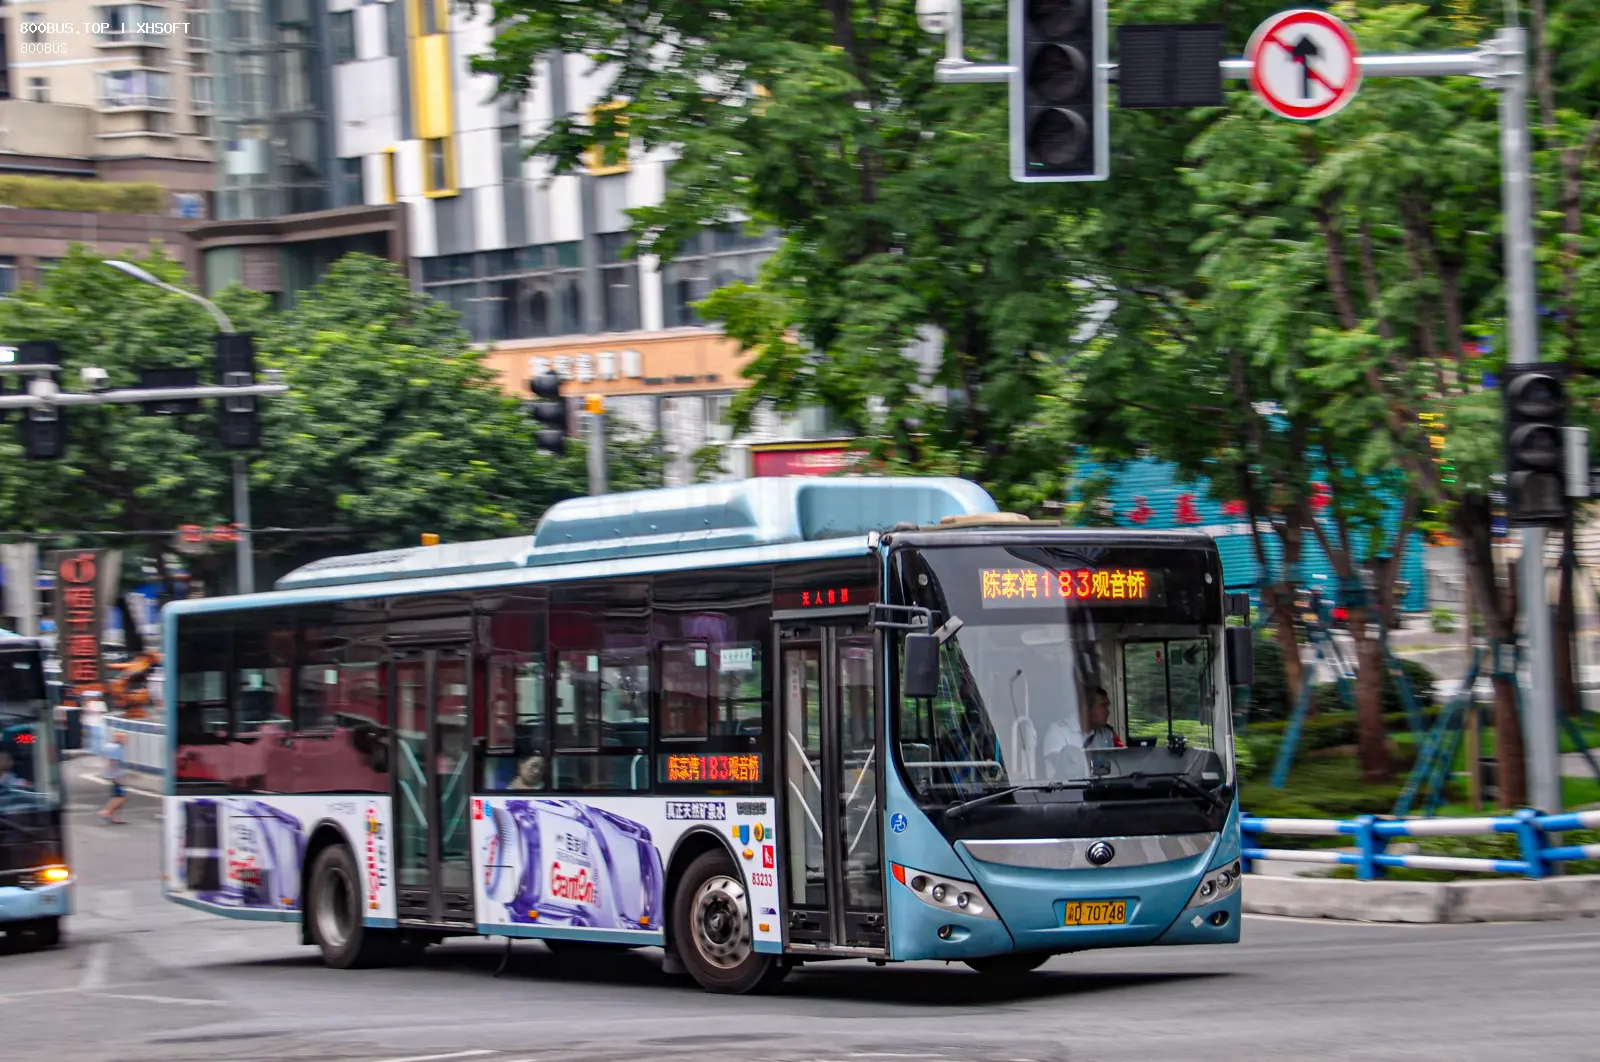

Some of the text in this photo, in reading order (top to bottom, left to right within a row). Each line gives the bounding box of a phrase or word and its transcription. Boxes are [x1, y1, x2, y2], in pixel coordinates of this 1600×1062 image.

[666, 802, 726, 820] 真正天然矿泉水
[751, 872, 773, 887] 83233
